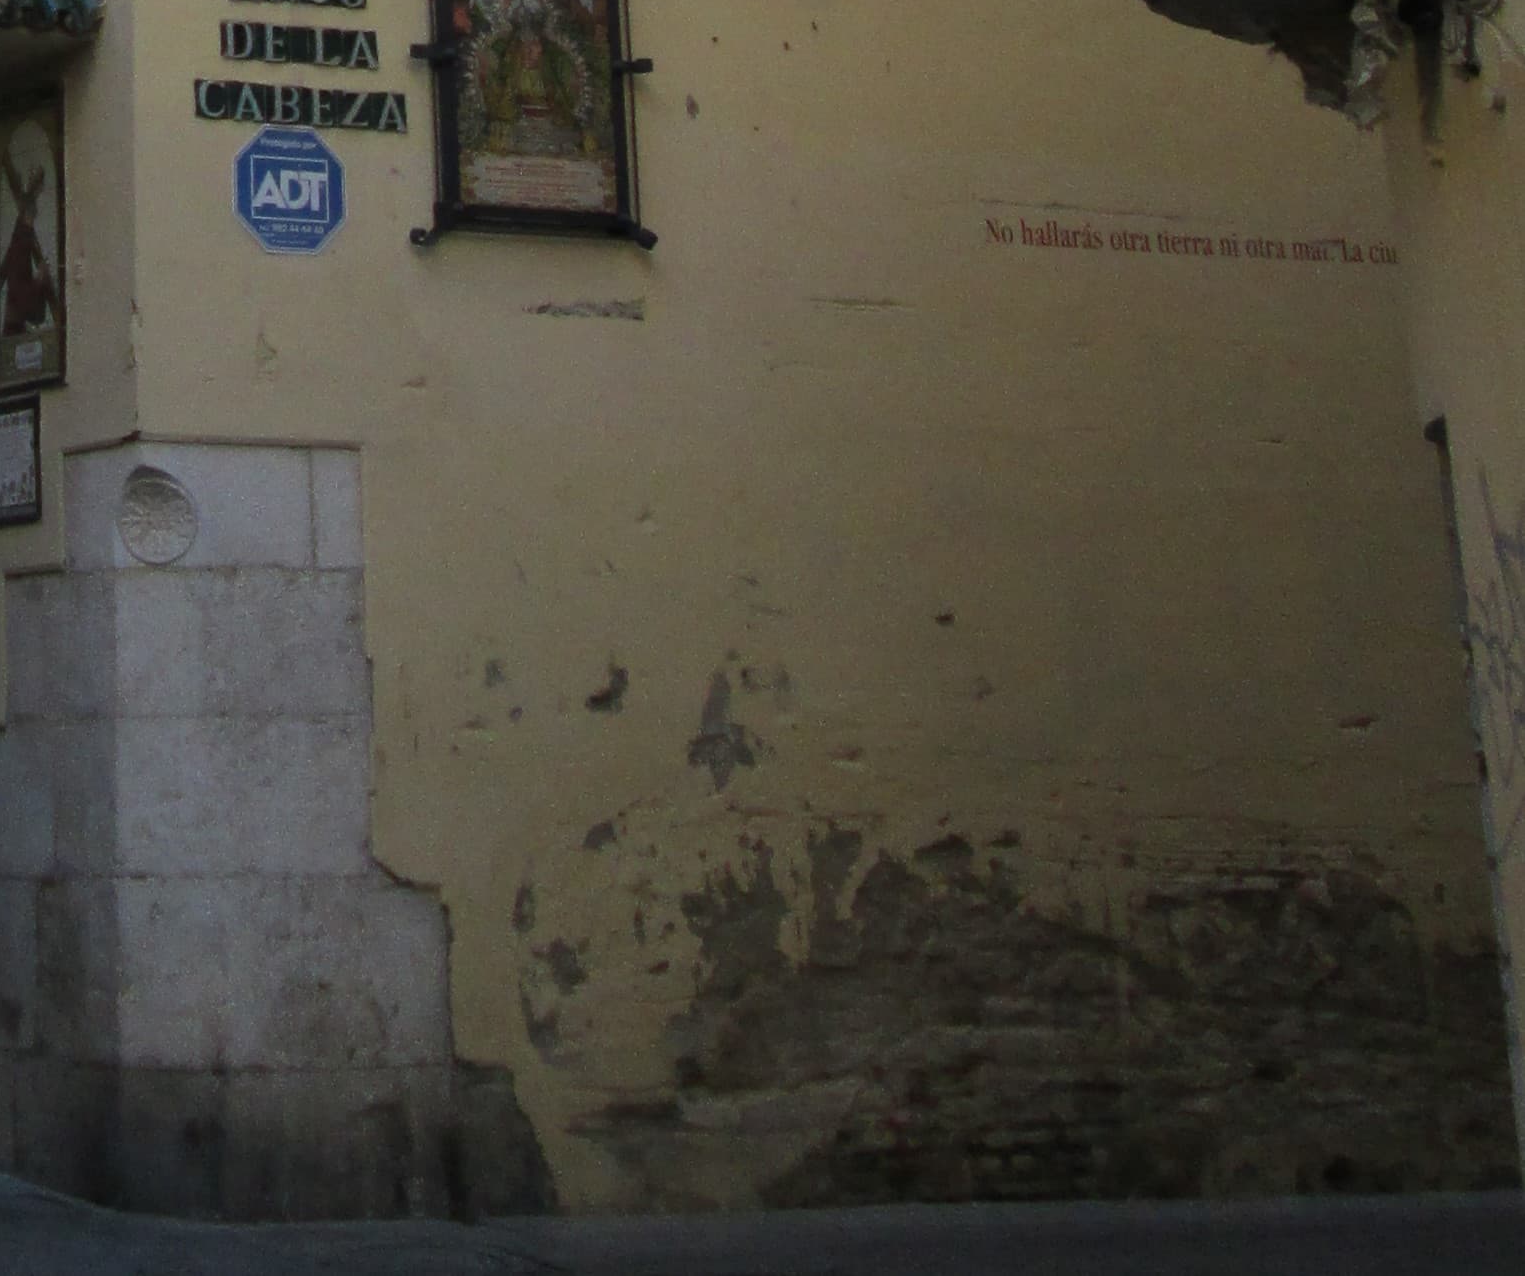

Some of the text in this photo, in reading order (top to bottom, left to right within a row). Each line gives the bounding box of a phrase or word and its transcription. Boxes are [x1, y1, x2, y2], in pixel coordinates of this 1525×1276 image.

[225, 22, 379, 70] DE LA
[198, 79, 408, 133] CABEZA
[252, 169, 328, 211] ADT
[985, 217, 1014, 245] No
[1019, 217, 1104, 250] hallarás
[1110, 229, 1152, 253] otra
[1157, 230, 1214, 256] tierra
[1219, 233, 1239, 258] ni
[1245, 236, 1286, 259] otra
